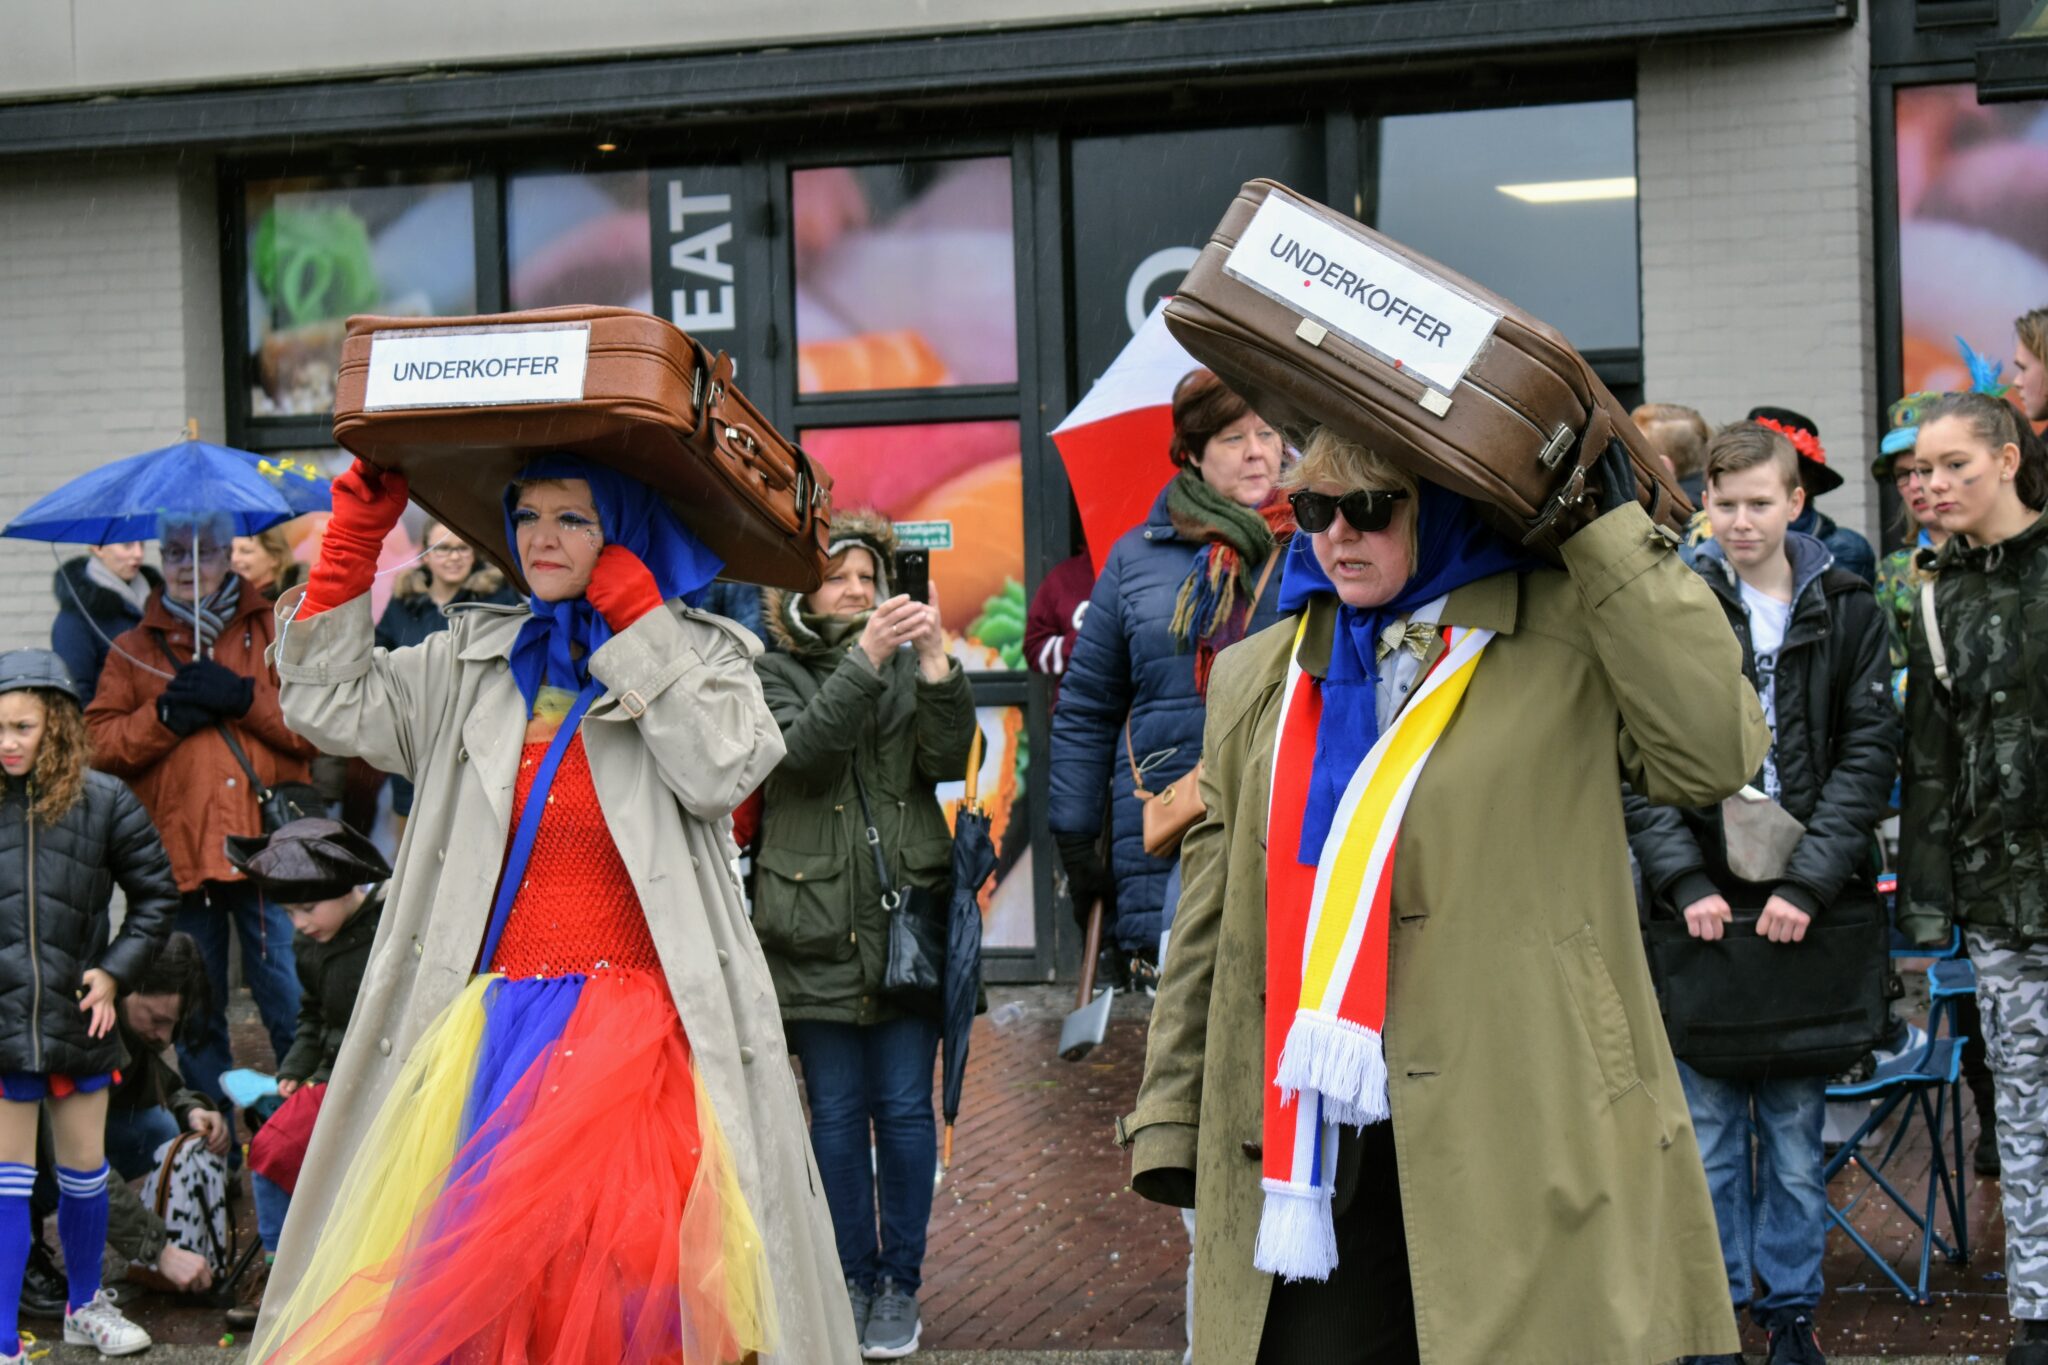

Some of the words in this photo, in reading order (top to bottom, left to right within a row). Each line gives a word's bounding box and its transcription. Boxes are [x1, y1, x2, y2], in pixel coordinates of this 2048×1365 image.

[668, 180, 736, 332] EAT
[1269, 233, 1452, 349] UNDERKOFFER
[393, 355, 560, 382] UNDERKOFFER
